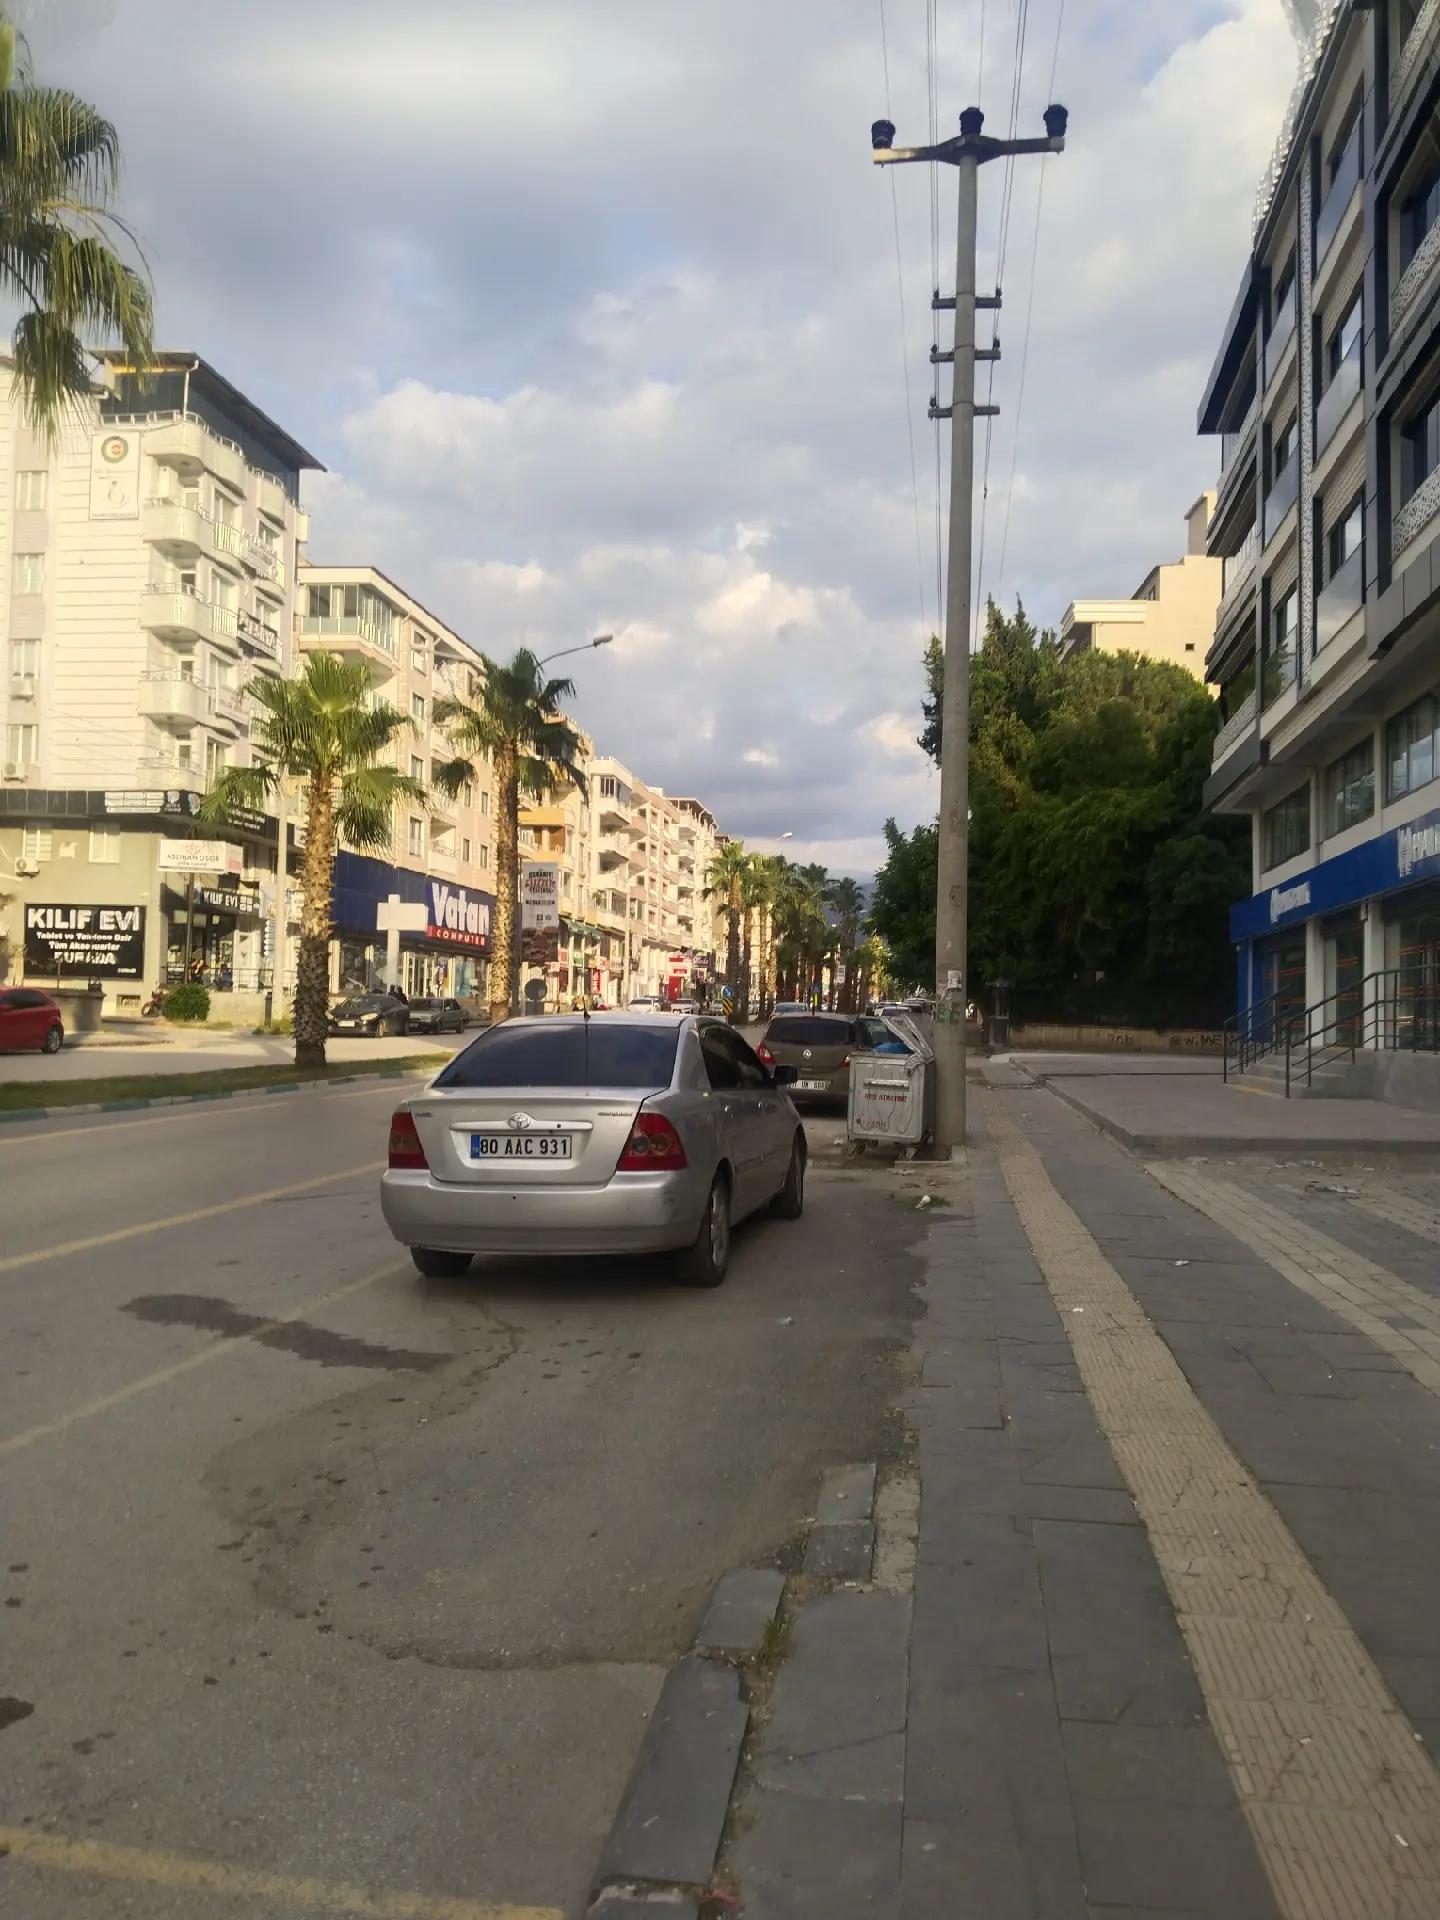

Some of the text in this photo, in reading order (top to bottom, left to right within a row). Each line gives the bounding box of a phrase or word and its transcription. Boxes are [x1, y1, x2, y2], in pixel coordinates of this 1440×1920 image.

[27, 906, 140, 931] KILIF EVİ
[432, 882, 489, 936] Vatan
[436, 929, 485, 946] COMPUTER
[480, 1138, 567, 1155] 80 AAC 931
